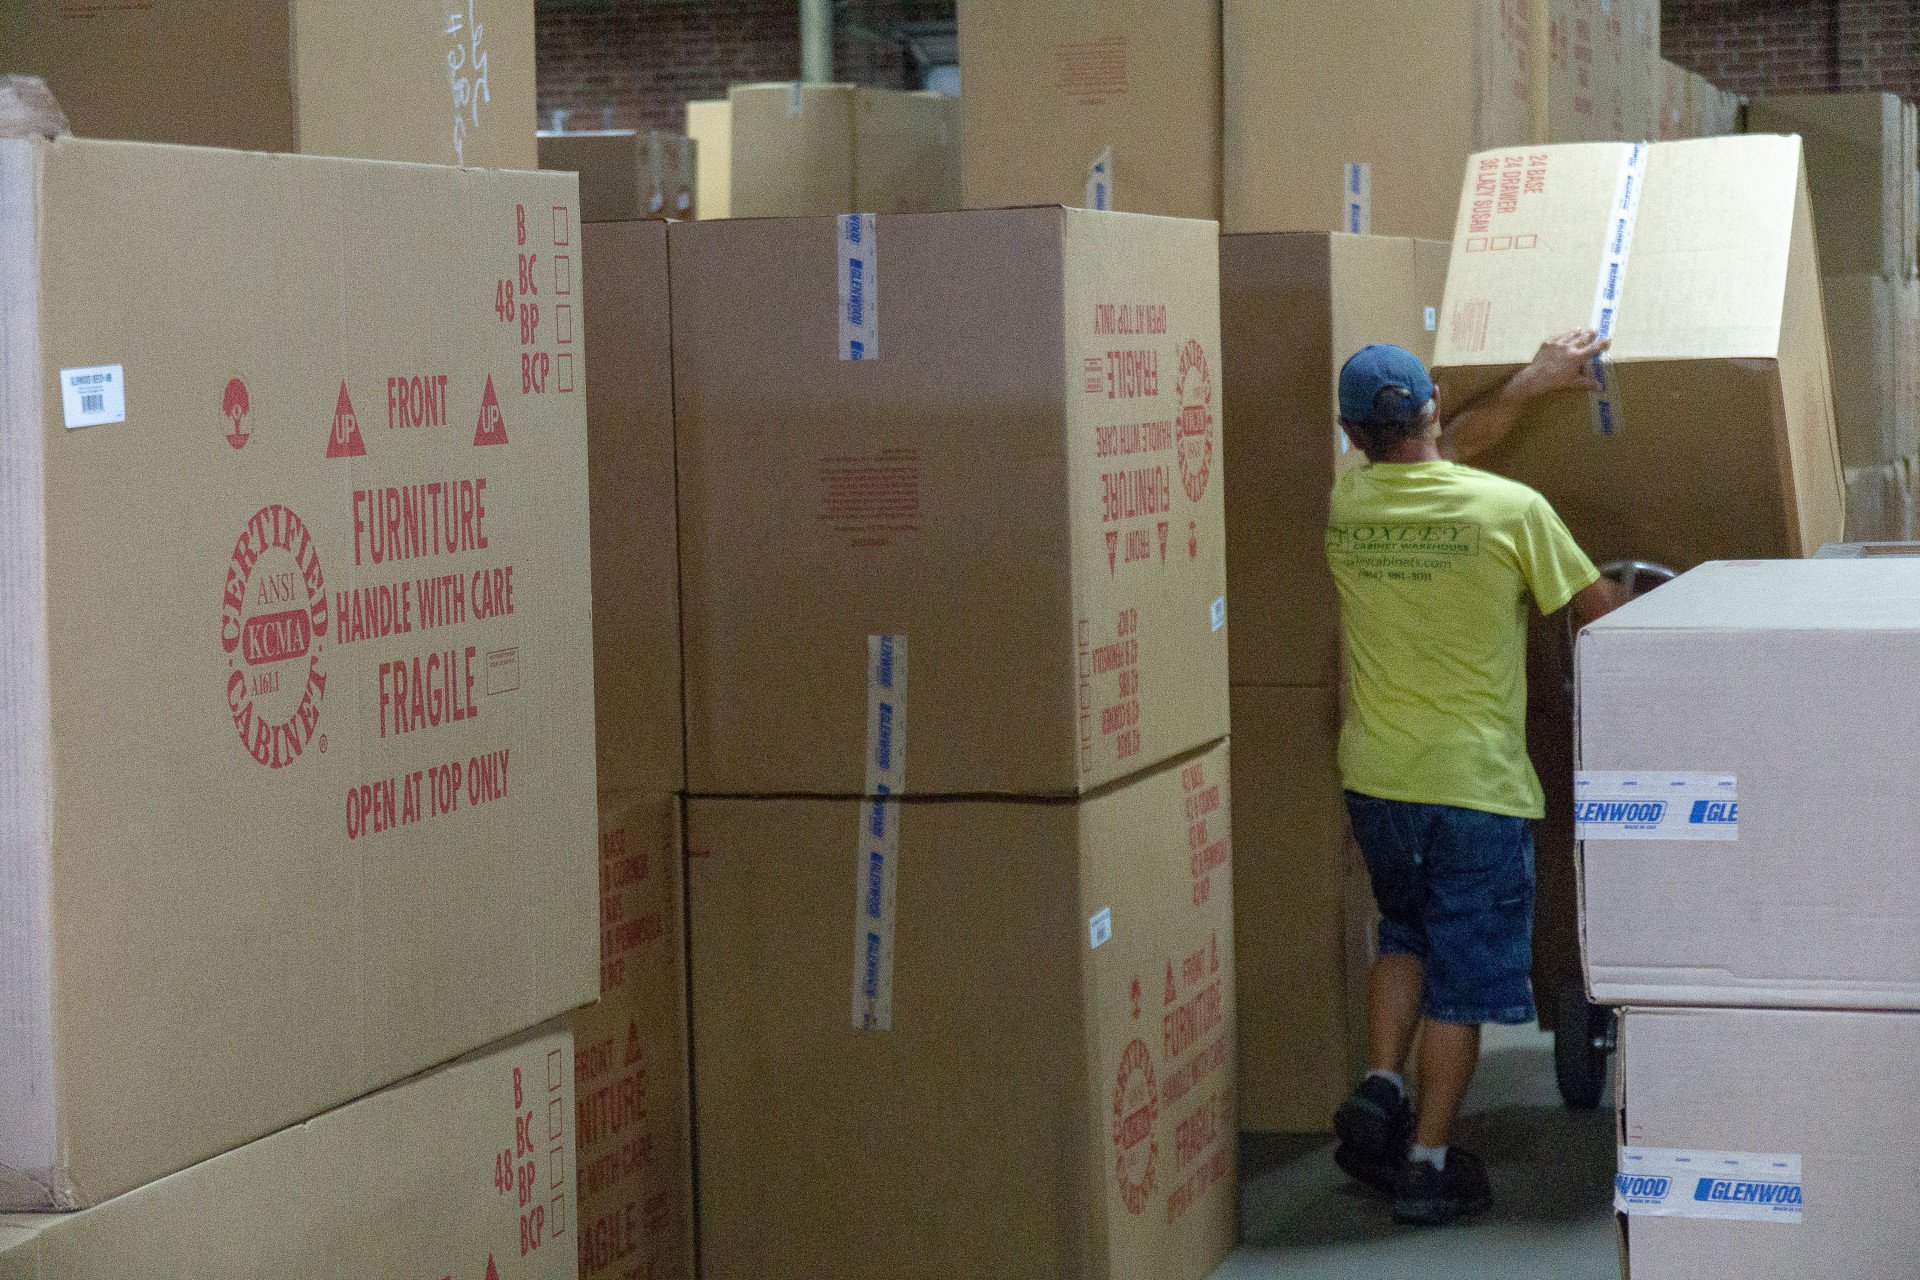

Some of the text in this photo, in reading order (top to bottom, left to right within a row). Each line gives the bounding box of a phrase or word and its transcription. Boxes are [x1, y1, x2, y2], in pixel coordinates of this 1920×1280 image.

[1475, 172, 1496, 197] LAZY
[1497, 156, 1523, 214] 24 DRAWER
[1524, 154, 1548, 194] 24 BASE
[516, 203, 526, 246] B
[1470, 200, 1492, 233] SUSAN
[518, 253, 538, 296] BC
[850, 268, 862, 325] GLENWOOD
[495, 279, 515, 323] 48
[520, 303, 540, 345] BP
[521, 352, 550, 395] BCP
[1106, 350, 1158, 399] FRAGILE
[387, 374, 448, 430] FRONT
[481, 404, 499, 434] UP
[334, 412, 357, 444] UP
[1102, 465, 1170, 523] FURNITURE
[352, 478, 489, 566] FURNITURE
[1353, 542, 1469, 551] CABINET WAREHOUSE
[221, 504, 329, 653] CERTIFIED
[257, 572, 296, 606] ANSI
[336, 565, 514, 645] HANDLE WITH CARE
[249, 616, 304, 660] KCMA
[227, 655, 328, 769] CABINET
[378, 646, 478, 738] FRAGILE
[346, 749, 510, 841] OPEN AT TOP ONLY
[513, 1067, 523, 1109] B
[515, 1111, 534, 1159] BC
[494, 1148, 514, 1195] 48
[518, 1162, 536, 1208] BP
[1711, 1181, 1802, 1204] GLENWOO
[520, 1205, 544, 1257] BCP
